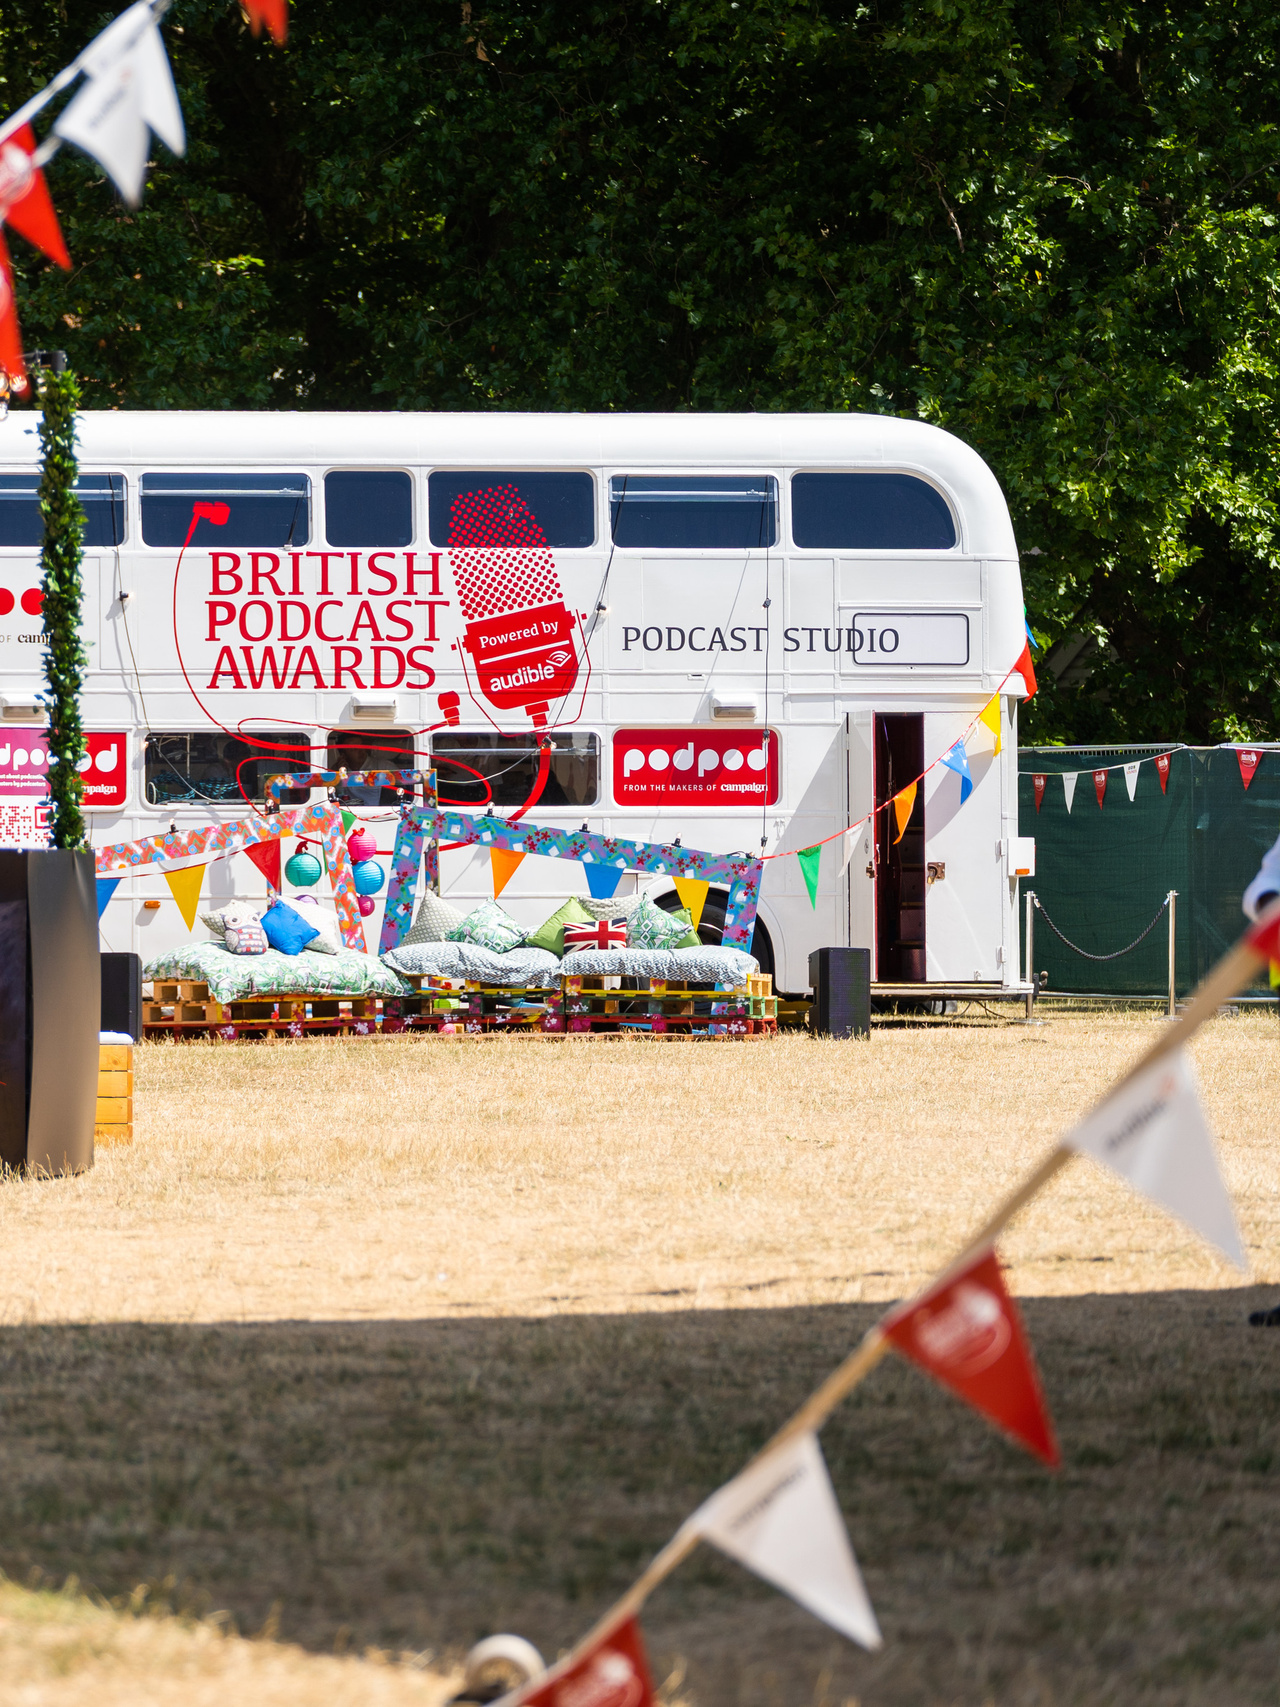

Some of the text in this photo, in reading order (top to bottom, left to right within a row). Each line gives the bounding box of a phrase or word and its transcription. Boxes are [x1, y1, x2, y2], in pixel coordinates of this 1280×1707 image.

[208, 551, 443, 596] BRITISH
[204, 600, 450, 642] PODCAST
[479, 621, 558, 648] Powered by
[621, 626, 900, 653] PODCAST STUDIO
[206, 645, 436, 689] AWARDS
[490, 663, 555, 692] audible
[623, 742, 768, 777] podpod
[720, 782, 768, 793] campaign
